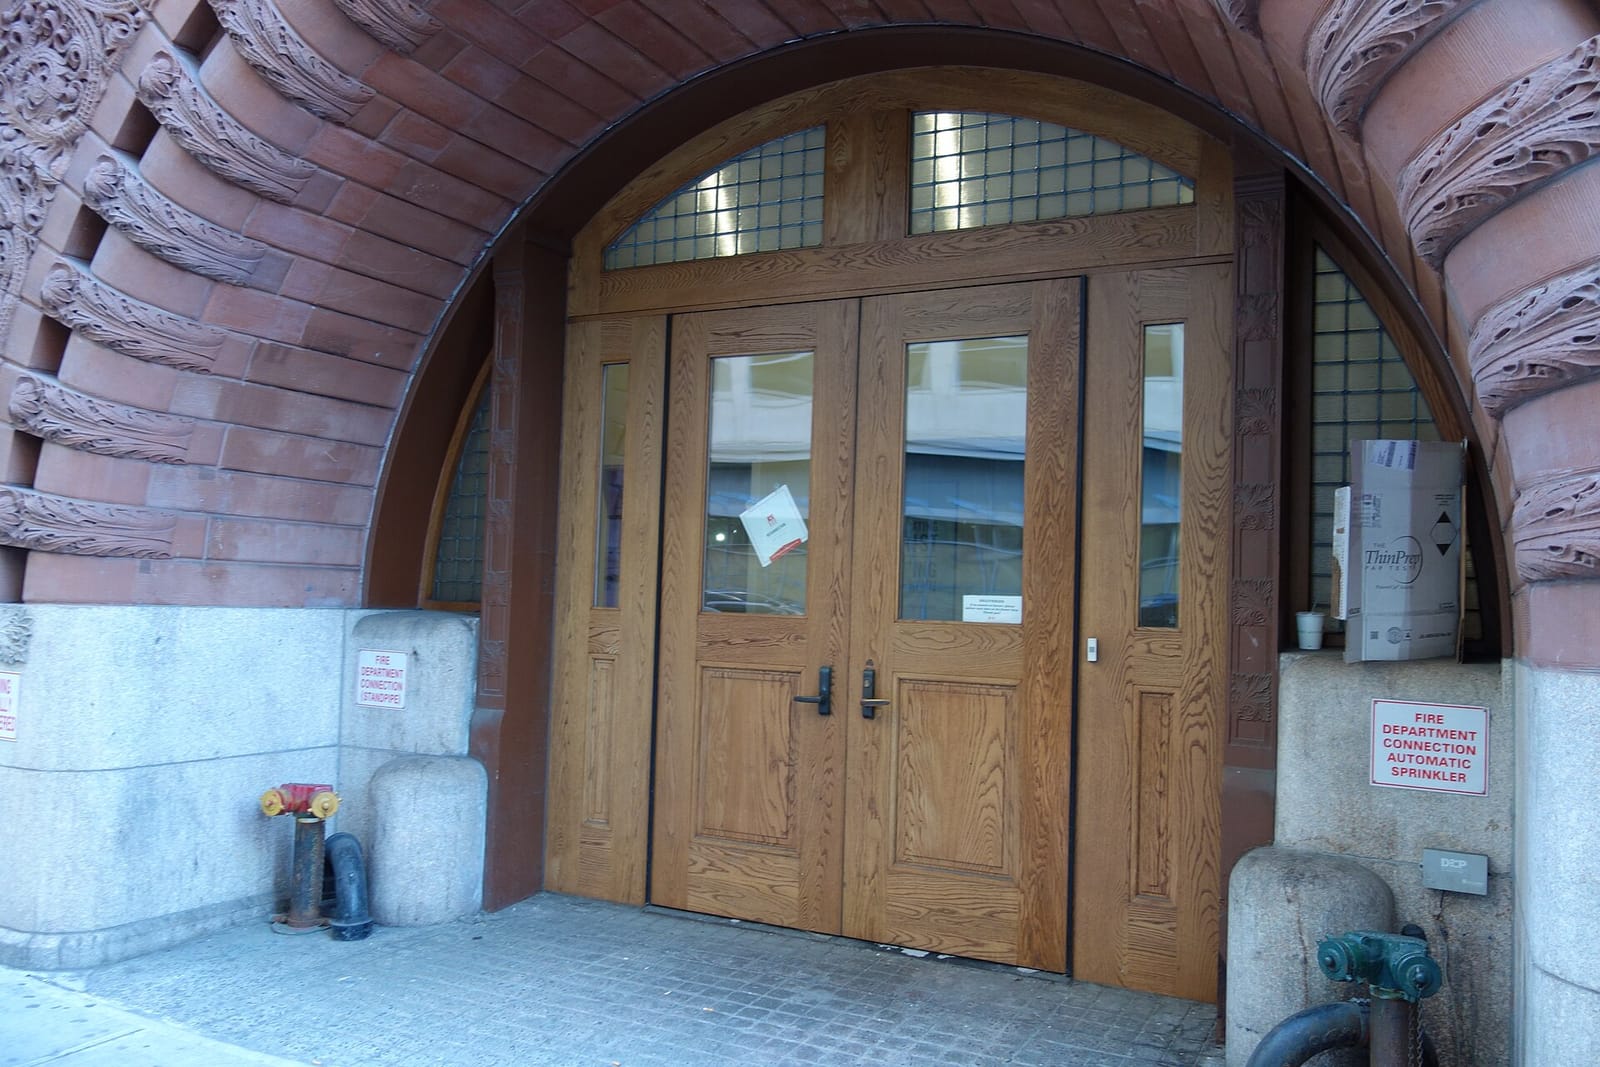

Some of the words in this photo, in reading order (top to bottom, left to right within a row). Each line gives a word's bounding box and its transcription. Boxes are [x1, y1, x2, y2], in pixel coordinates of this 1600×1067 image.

[1365, 550, 1422, 566] ThinPrep
[376, 655, 390, 665] FIRE
[361, 666, 404, 678] DEPARTMENT
[361, 678, 402, 691] CONNECTION
[1415, 713, 1445, 724] FIRE
[1382, 724, 1477, 741] DEPARTMENT
[1383, 738, 1477, 755] CONNECTION
[1387, 752, 1472, 769] AUTOMATIC
[1391, 766, 1467, 783] SPRINKLER
